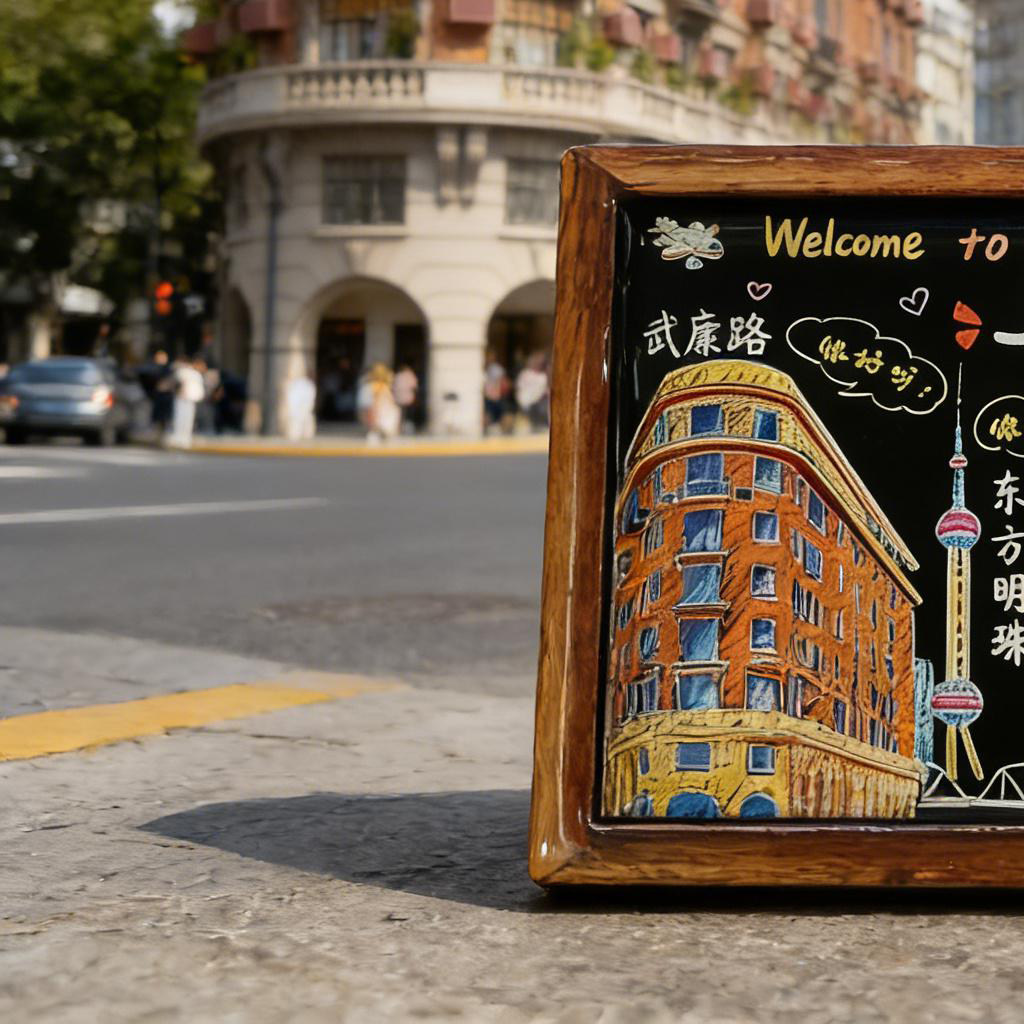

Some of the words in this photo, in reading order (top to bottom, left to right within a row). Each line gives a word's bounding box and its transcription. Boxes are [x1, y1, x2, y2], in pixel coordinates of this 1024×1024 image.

[765, 215, 925, 260] Welcome
[958, 227, 1009, 262] to
[643, 308, 773, 359] 武康路
